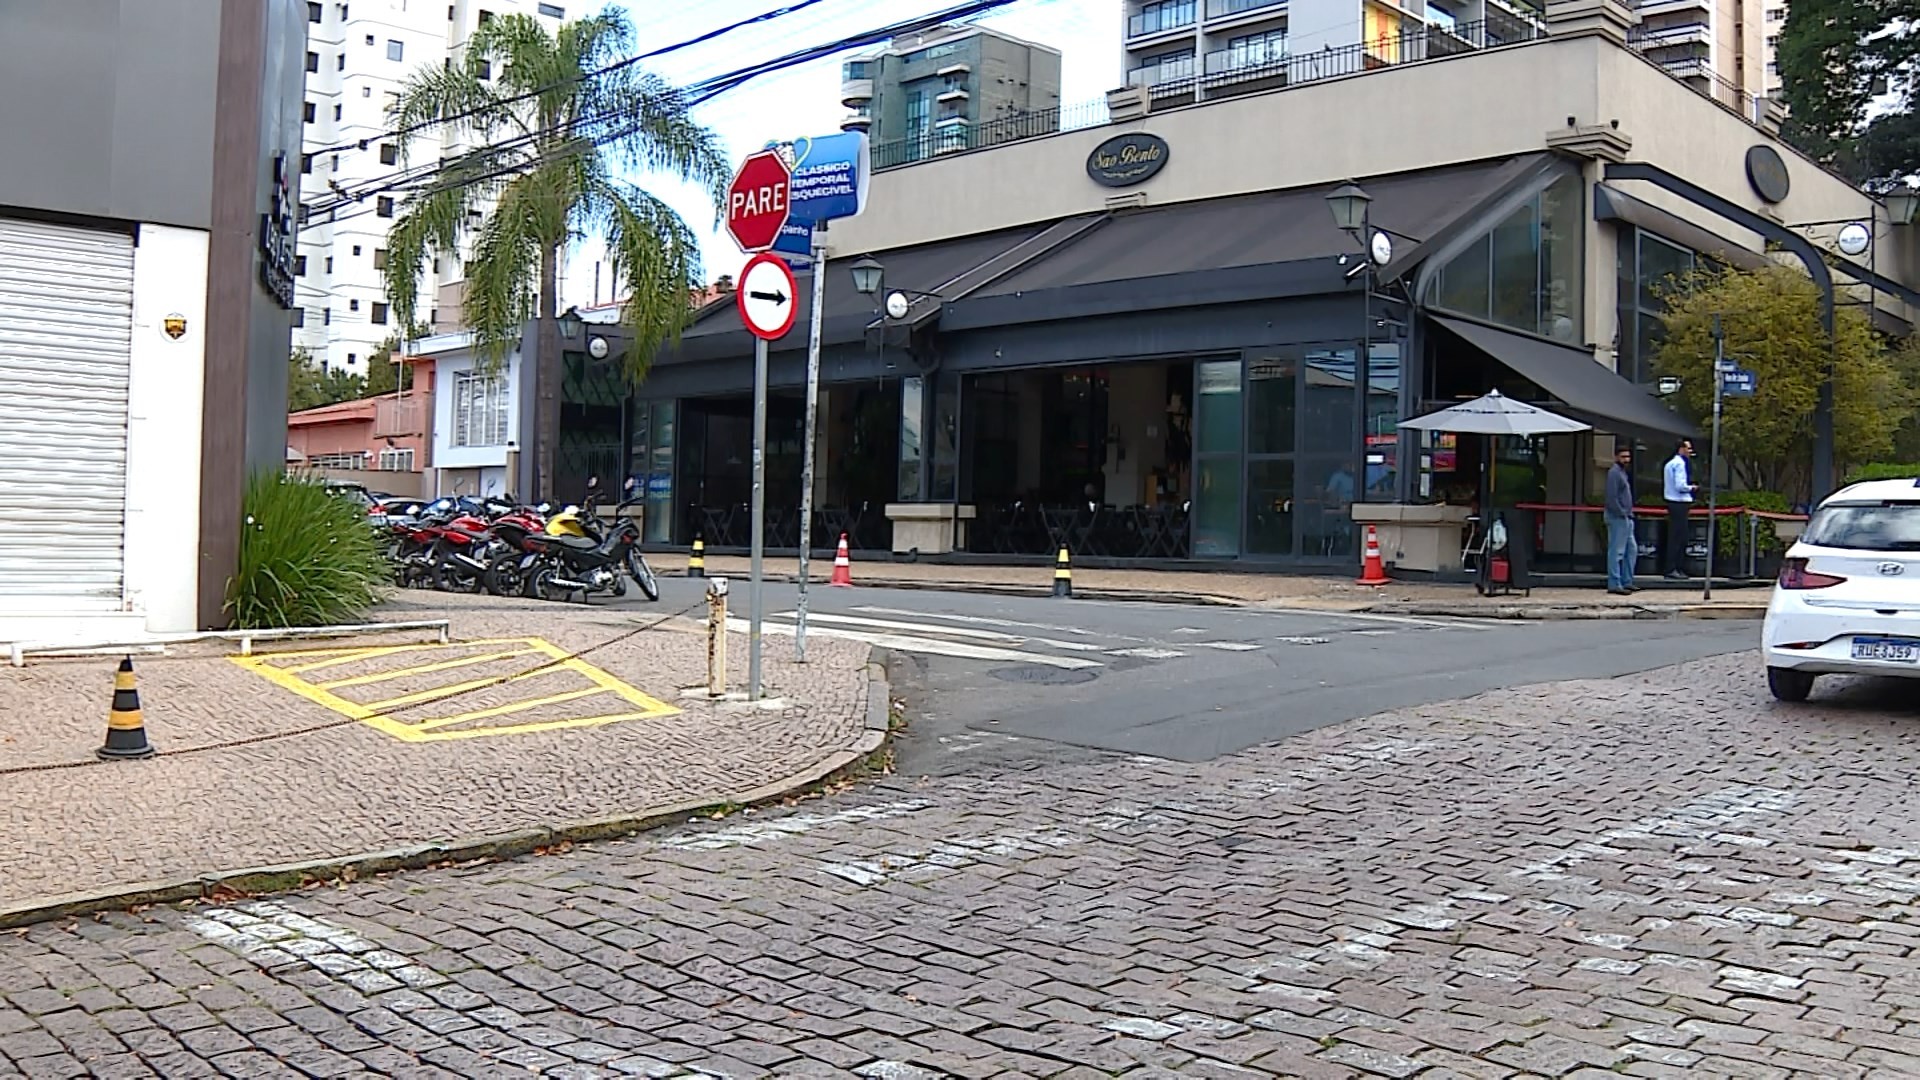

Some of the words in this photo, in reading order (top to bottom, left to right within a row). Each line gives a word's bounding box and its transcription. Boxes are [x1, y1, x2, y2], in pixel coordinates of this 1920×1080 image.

[1119, 144, 1160, 163] Bento
[791, 173, 850, 188] TEMPORAL
[731, 182, 786, 220] PARE
